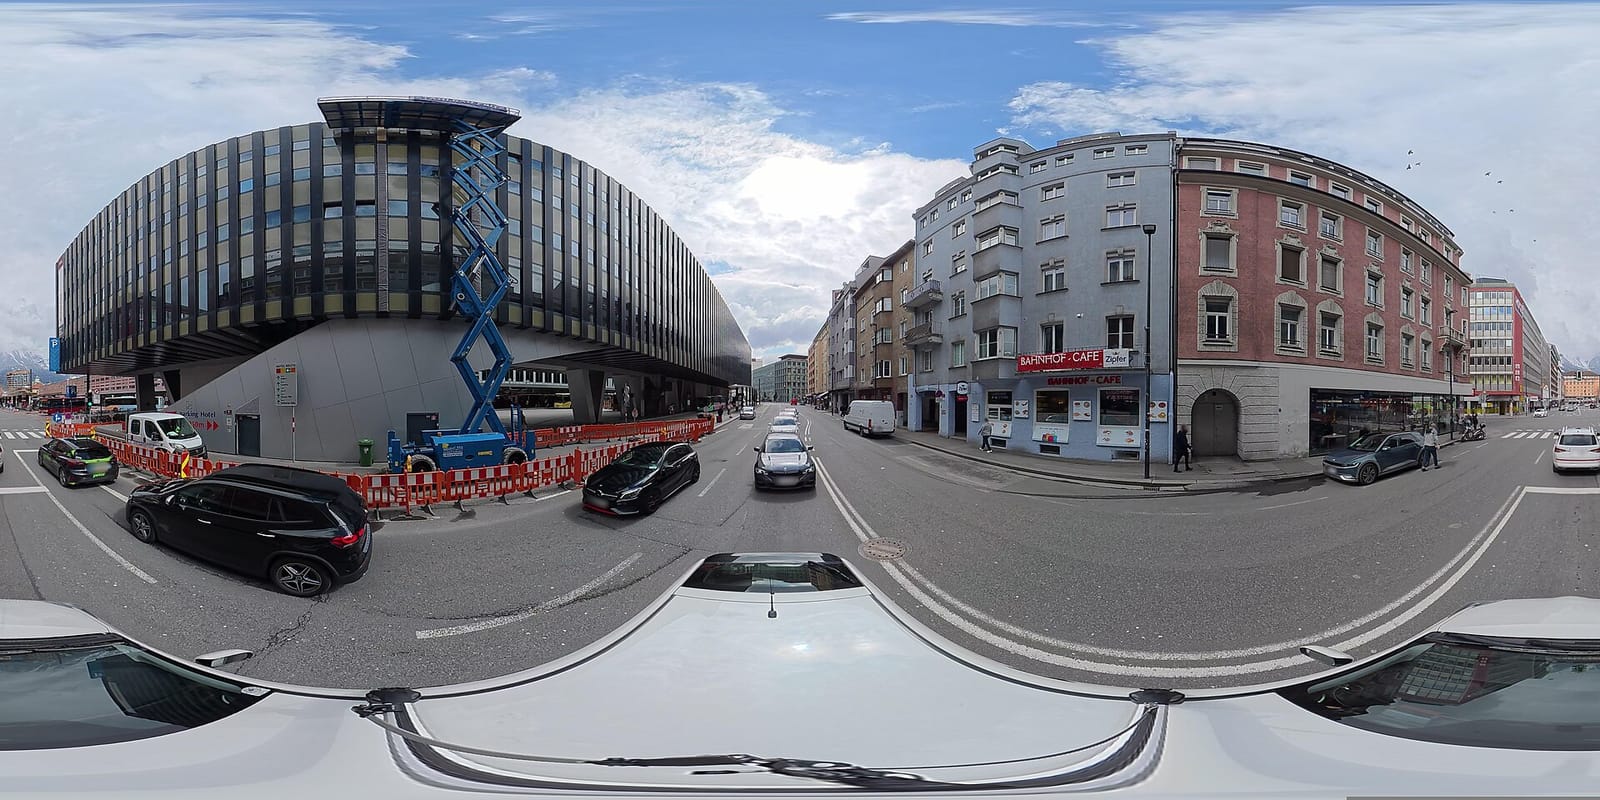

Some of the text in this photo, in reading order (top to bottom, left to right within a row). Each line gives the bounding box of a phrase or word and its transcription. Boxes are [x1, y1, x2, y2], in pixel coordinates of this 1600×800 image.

[1020, 354, 1066, 366] BAHNHOF
[1072, 351, 1100, 362] CAFE
[1105, 355, 1126, 364] Zipfer
[1048, 376, 1089, 385] BAHNHOF
[1096, 376, 1121, 384] CAFE
